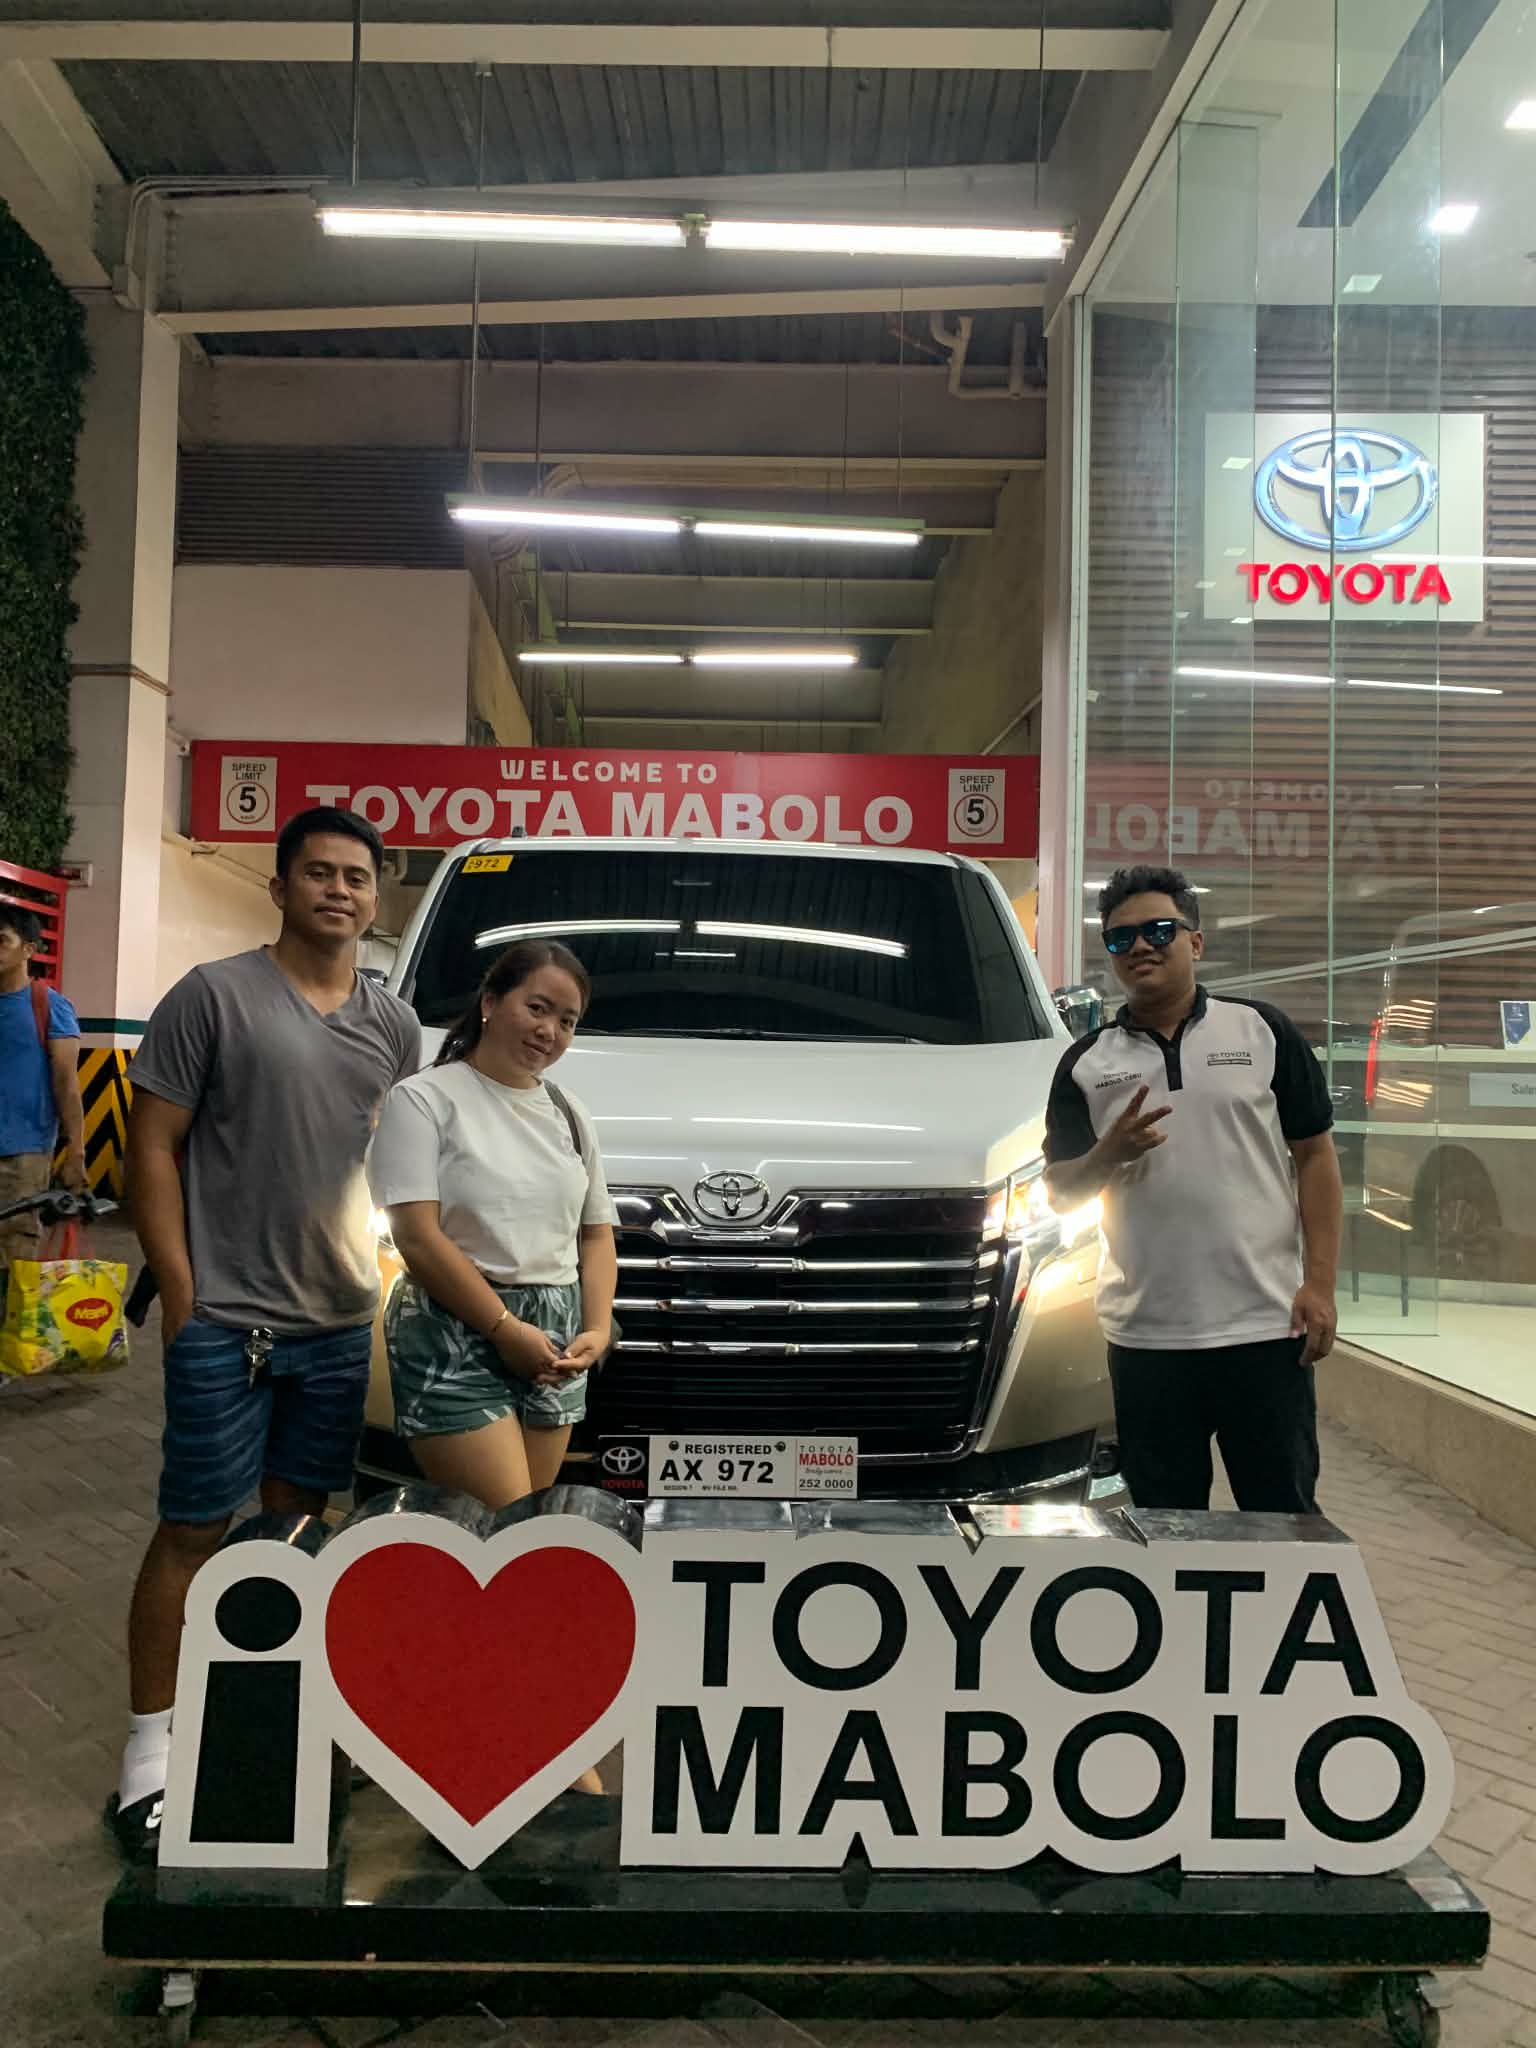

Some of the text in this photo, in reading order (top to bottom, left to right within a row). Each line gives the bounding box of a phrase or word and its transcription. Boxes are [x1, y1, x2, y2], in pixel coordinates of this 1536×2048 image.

[1238, 563, 1451, 604] TOYOTA
[232, 763, 267, 772] SPEED
[235, 772, 262, 781] LIMIT
[500, 760, 717, 784] WELCOME TO
[959, 775, 995, 784] SPEED
[963, 784, 992, 793] LIMIT
[239, 786, 257, 813] 5
[305, 784, 913, 844] TOYOTA MABOLO
[967, 798, 985, 825] 5
[685, 1444, 772, 1455] REGISTERED
[800, 1453, 854, 1466] MABOLO
[659, 1460, 774, 1484] AX 972
[602, 1479, 645, 1489] TOYOTA
[799, 1479, 854, 1488] 252 0000
[672, 1560, 1378, 1697] TOYOTA
[651, 1705, 1426, 1843] MABOLO
